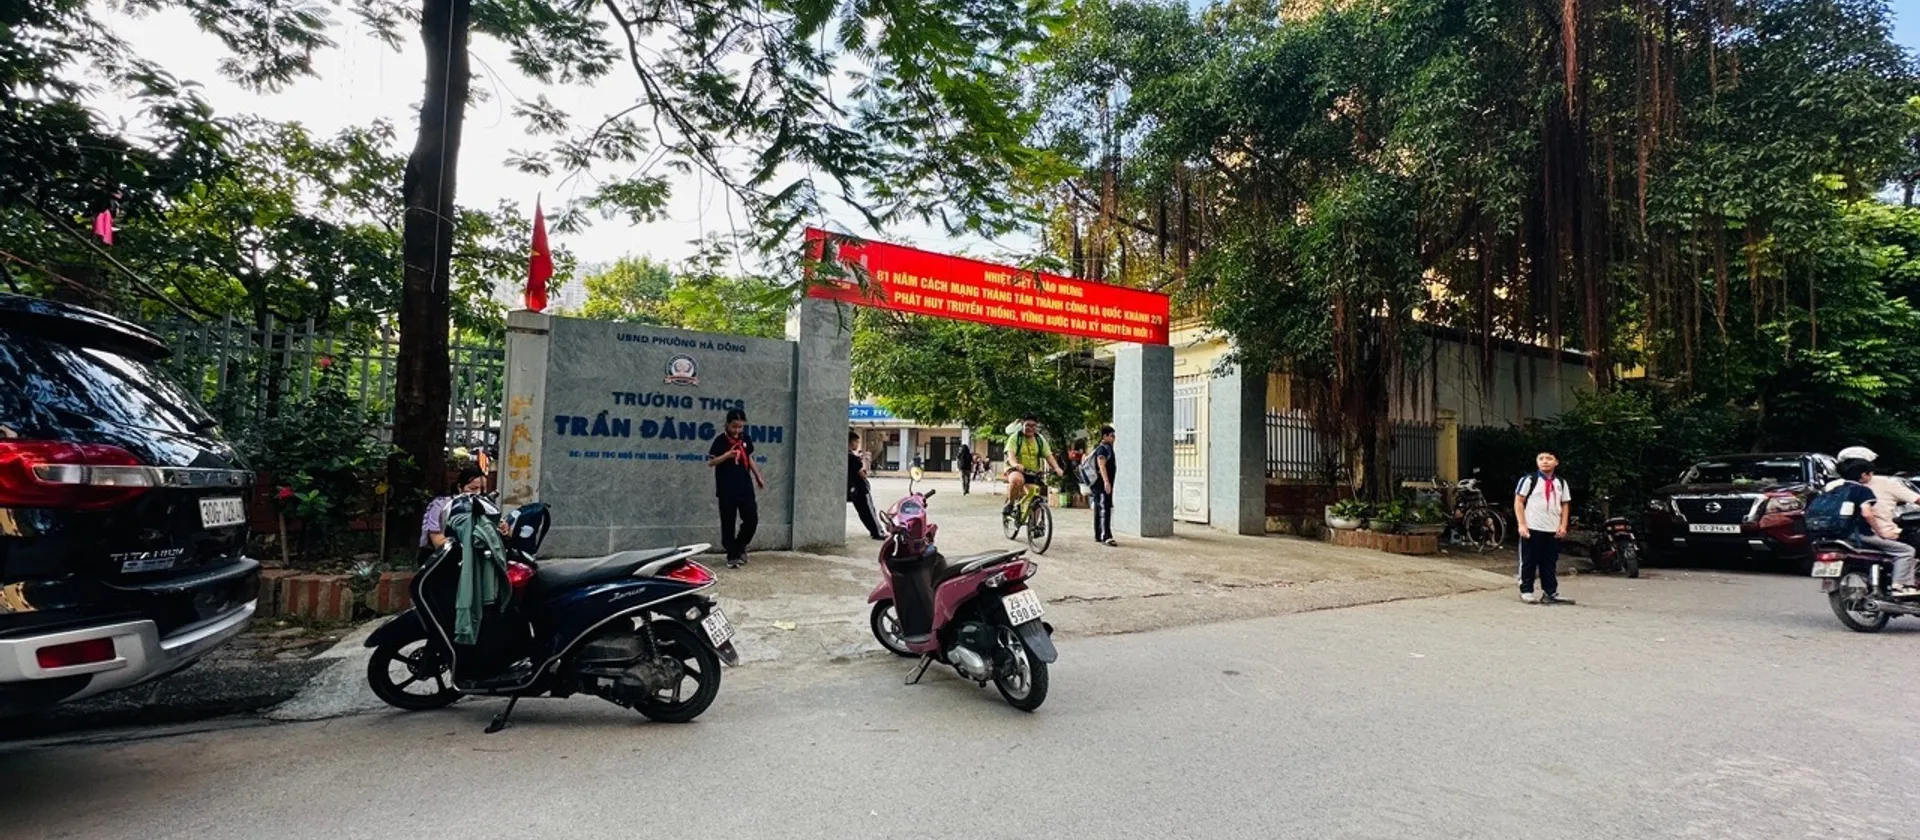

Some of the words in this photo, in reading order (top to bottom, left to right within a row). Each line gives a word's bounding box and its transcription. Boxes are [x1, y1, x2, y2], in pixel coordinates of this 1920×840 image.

[877, 269, 889, 283] 81
[893, 271, 918, 287] NĂM
[920, 276, 948, 292] CÁCH
[950, 282, 979, 298] MẠNG
[982, 286, 1012, 303] THÁNG
[1014, 292, 1033, 306] TÁM
[1035, 296, 1063, 310] THÀNH
[1065, 301, 1088, 314] CÔNG
[1089, 304, 1100, 316] VÀ
[1123, 311, 1150, 323] KHÁNH
[984, 271, 1011, 287] NHIỆT
[1058, 283, 1083, 298] MỪNG
[894, 291, 921, 307] PHÁT
[923, 296, 944, 310] HUY
[1070, 318, 1087, 330] VÀO
[1101, 323, 1132, 336] NGUYÊN
[616, 333, 649, 343] UBND
[652, 335, 696, 348] PHƯỜNG
[699, 339, 714, 349] HÀ
[612, 391, 693, 409] TRƯỜNG
[699, 397, 745, 410] THCS
[554, 410, 631, 438] TRẦN
[640, 416, 716, 441] ĐĂNG
